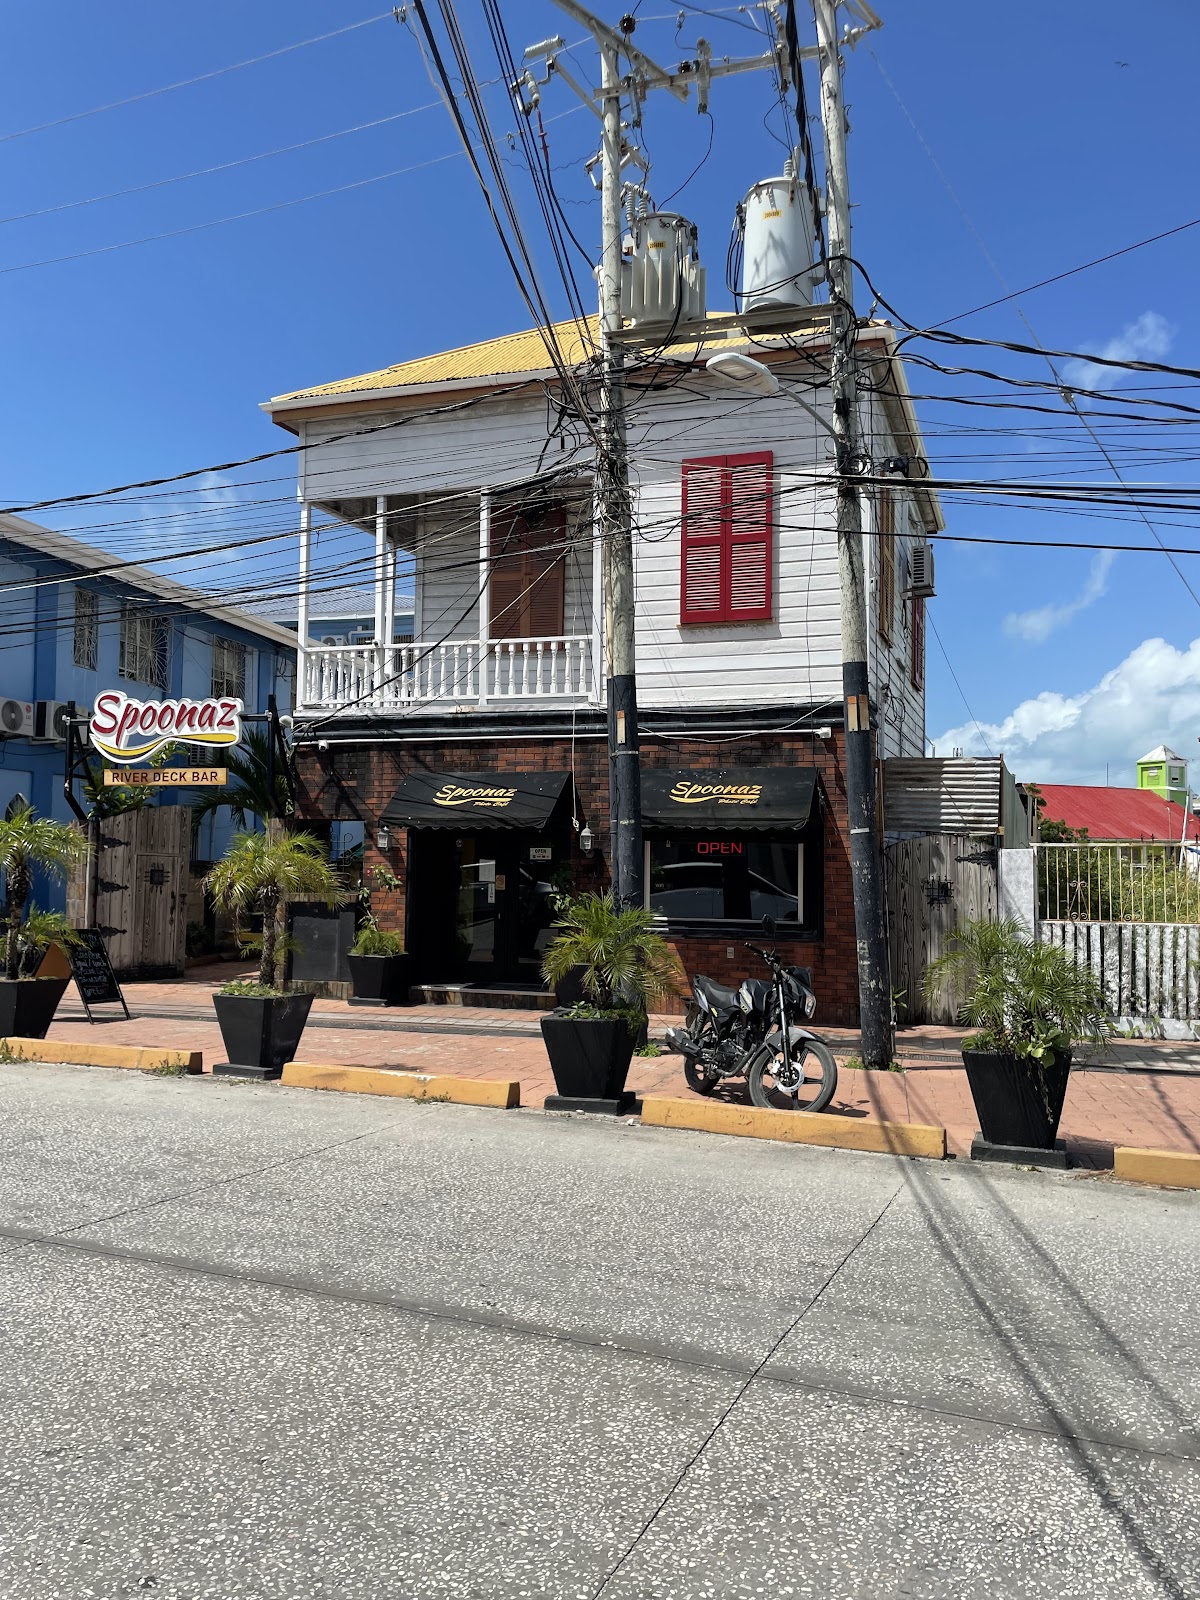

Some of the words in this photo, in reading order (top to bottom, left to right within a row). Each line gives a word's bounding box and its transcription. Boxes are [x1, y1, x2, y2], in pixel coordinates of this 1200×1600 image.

[92, 695, 237, 748] Spoonaz
[112, 772, 148, 783] RIVER
[153, 771, 188, 783] DECK
[192, 771, 218, 782] BAR
[435, 784, 518, 801] Spoonaz
[670, 781, 763, 798] Spoonaz
[697, 841, 742, 854] OPEN
